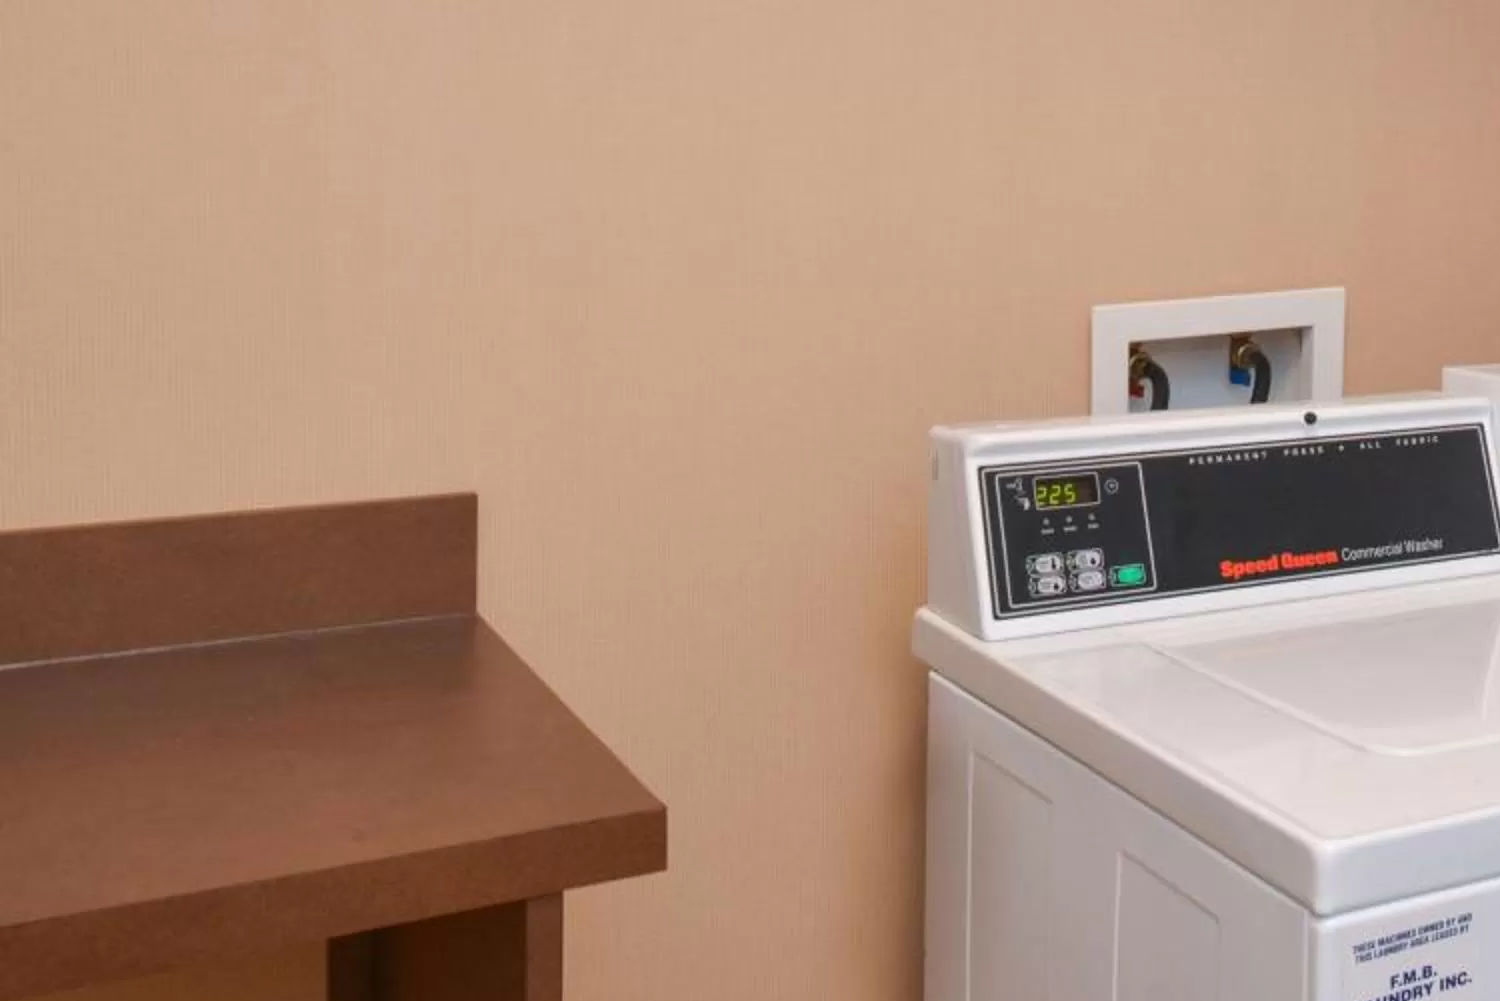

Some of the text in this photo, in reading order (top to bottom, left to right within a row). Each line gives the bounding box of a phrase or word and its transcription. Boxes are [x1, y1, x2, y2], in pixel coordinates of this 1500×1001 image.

[1188, 451, 1268, 466] PERMANENT
[1283, 445, 1325, 457] PRESS
[1359, 441, 1382, 450] ALL
[1036, 483, 1076, 505] 225
[1219, 537, 1444, 580] Speed Queen Commercial Washer
[1389, 965, 1439, 989] F.M.B.
[1438, 971, 1473, 992] INC.
